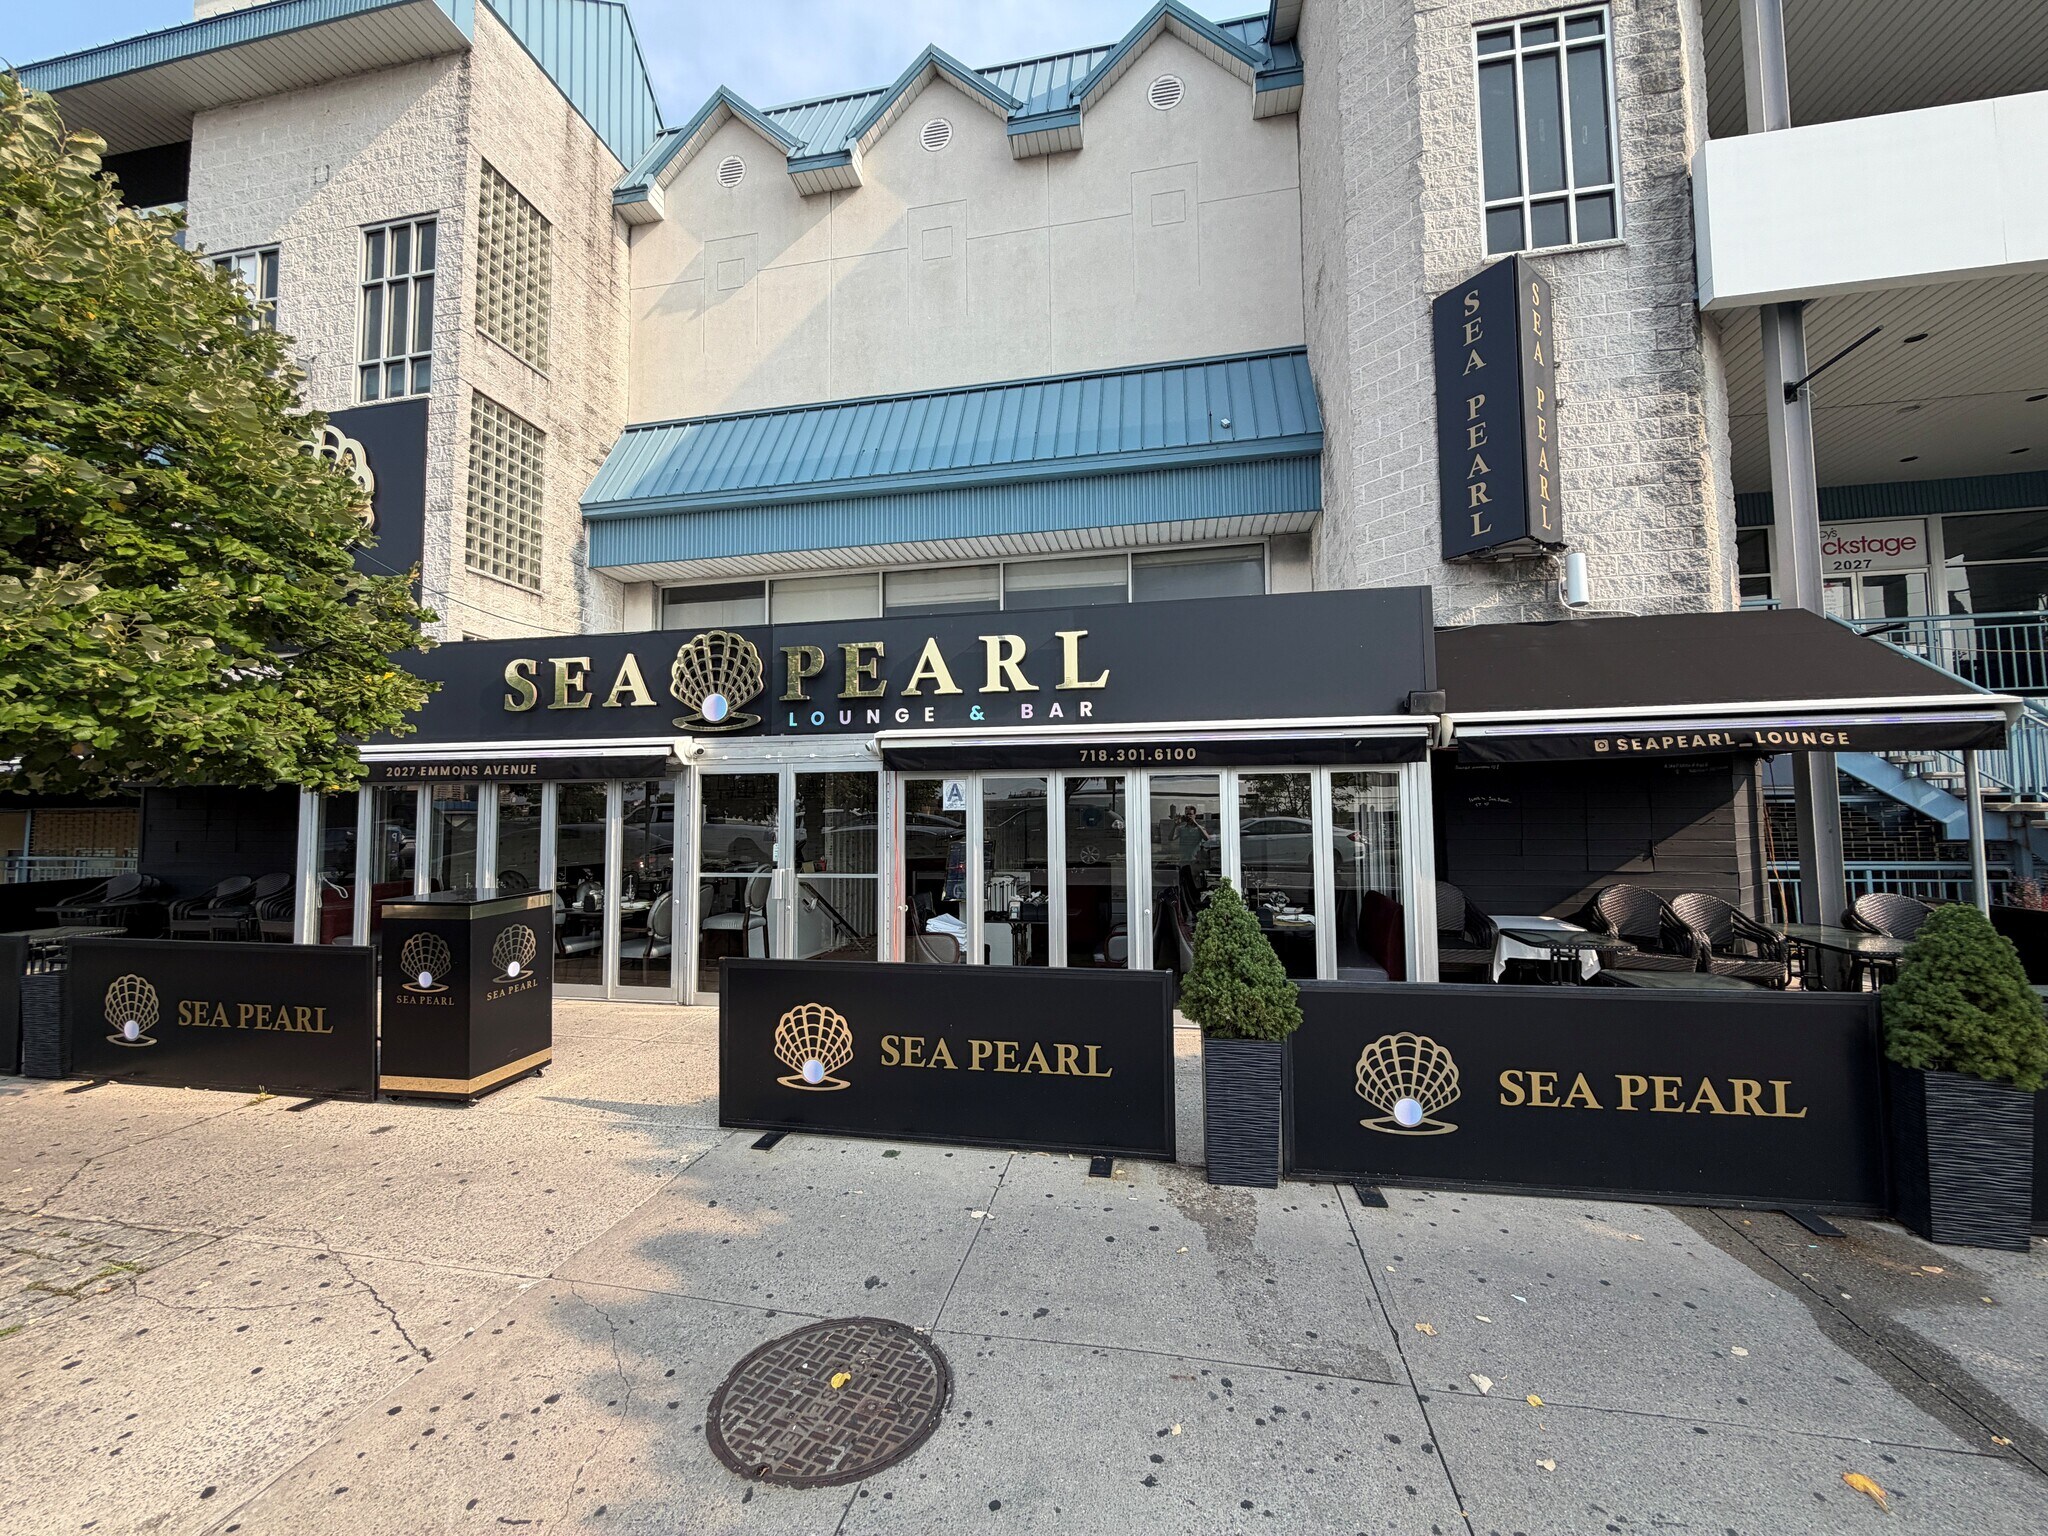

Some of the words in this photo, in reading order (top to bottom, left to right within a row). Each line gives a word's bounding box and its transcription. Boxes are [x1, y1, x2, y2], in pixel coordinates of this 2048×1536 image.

[1462, 289, 1487, 377] SEA
[1531, 282, 1545, 367] SEA
[1466, 394, 1493, 537] PEARL
[1535, 386, 1552, 531] PEARL
[1822, 535, 1917, 557] ckstage
[1833, 559, 1872, 571] 2027
[503, 653, 657, 712] SEA
[779, 630, 1110, 701] PEARL
[789, 706, 935, 727] LOUNGE
[969, 705, 985, 721] &
[1020, 701, 1093, 720] BAR
[1079, 747, 1197, 763] 718.301.6100
[386, 766, 416, 777] 2027
[420, 765, 479, 776] EMMONS
[483, 764, 537, 775] AVENUE
[947, 783, 963, 802] A
[396, 995, 417, 1004] SEA
[419, 996, 455, 1006] PEARL
[486, 990, 506, 1001] SEA
[508, 979, 538, 994] PEARL
[177, 1000, 232, 1029] SEA
[236, 1004, 334, 1034] PEARL
[880, 1035, 959, 1070] SEA
[967, 1039, 1114, 1078] PEARL
[1499, 1070, 1604, 1110] SEA
[1614, 1074, 1808, 1119] PEARL
